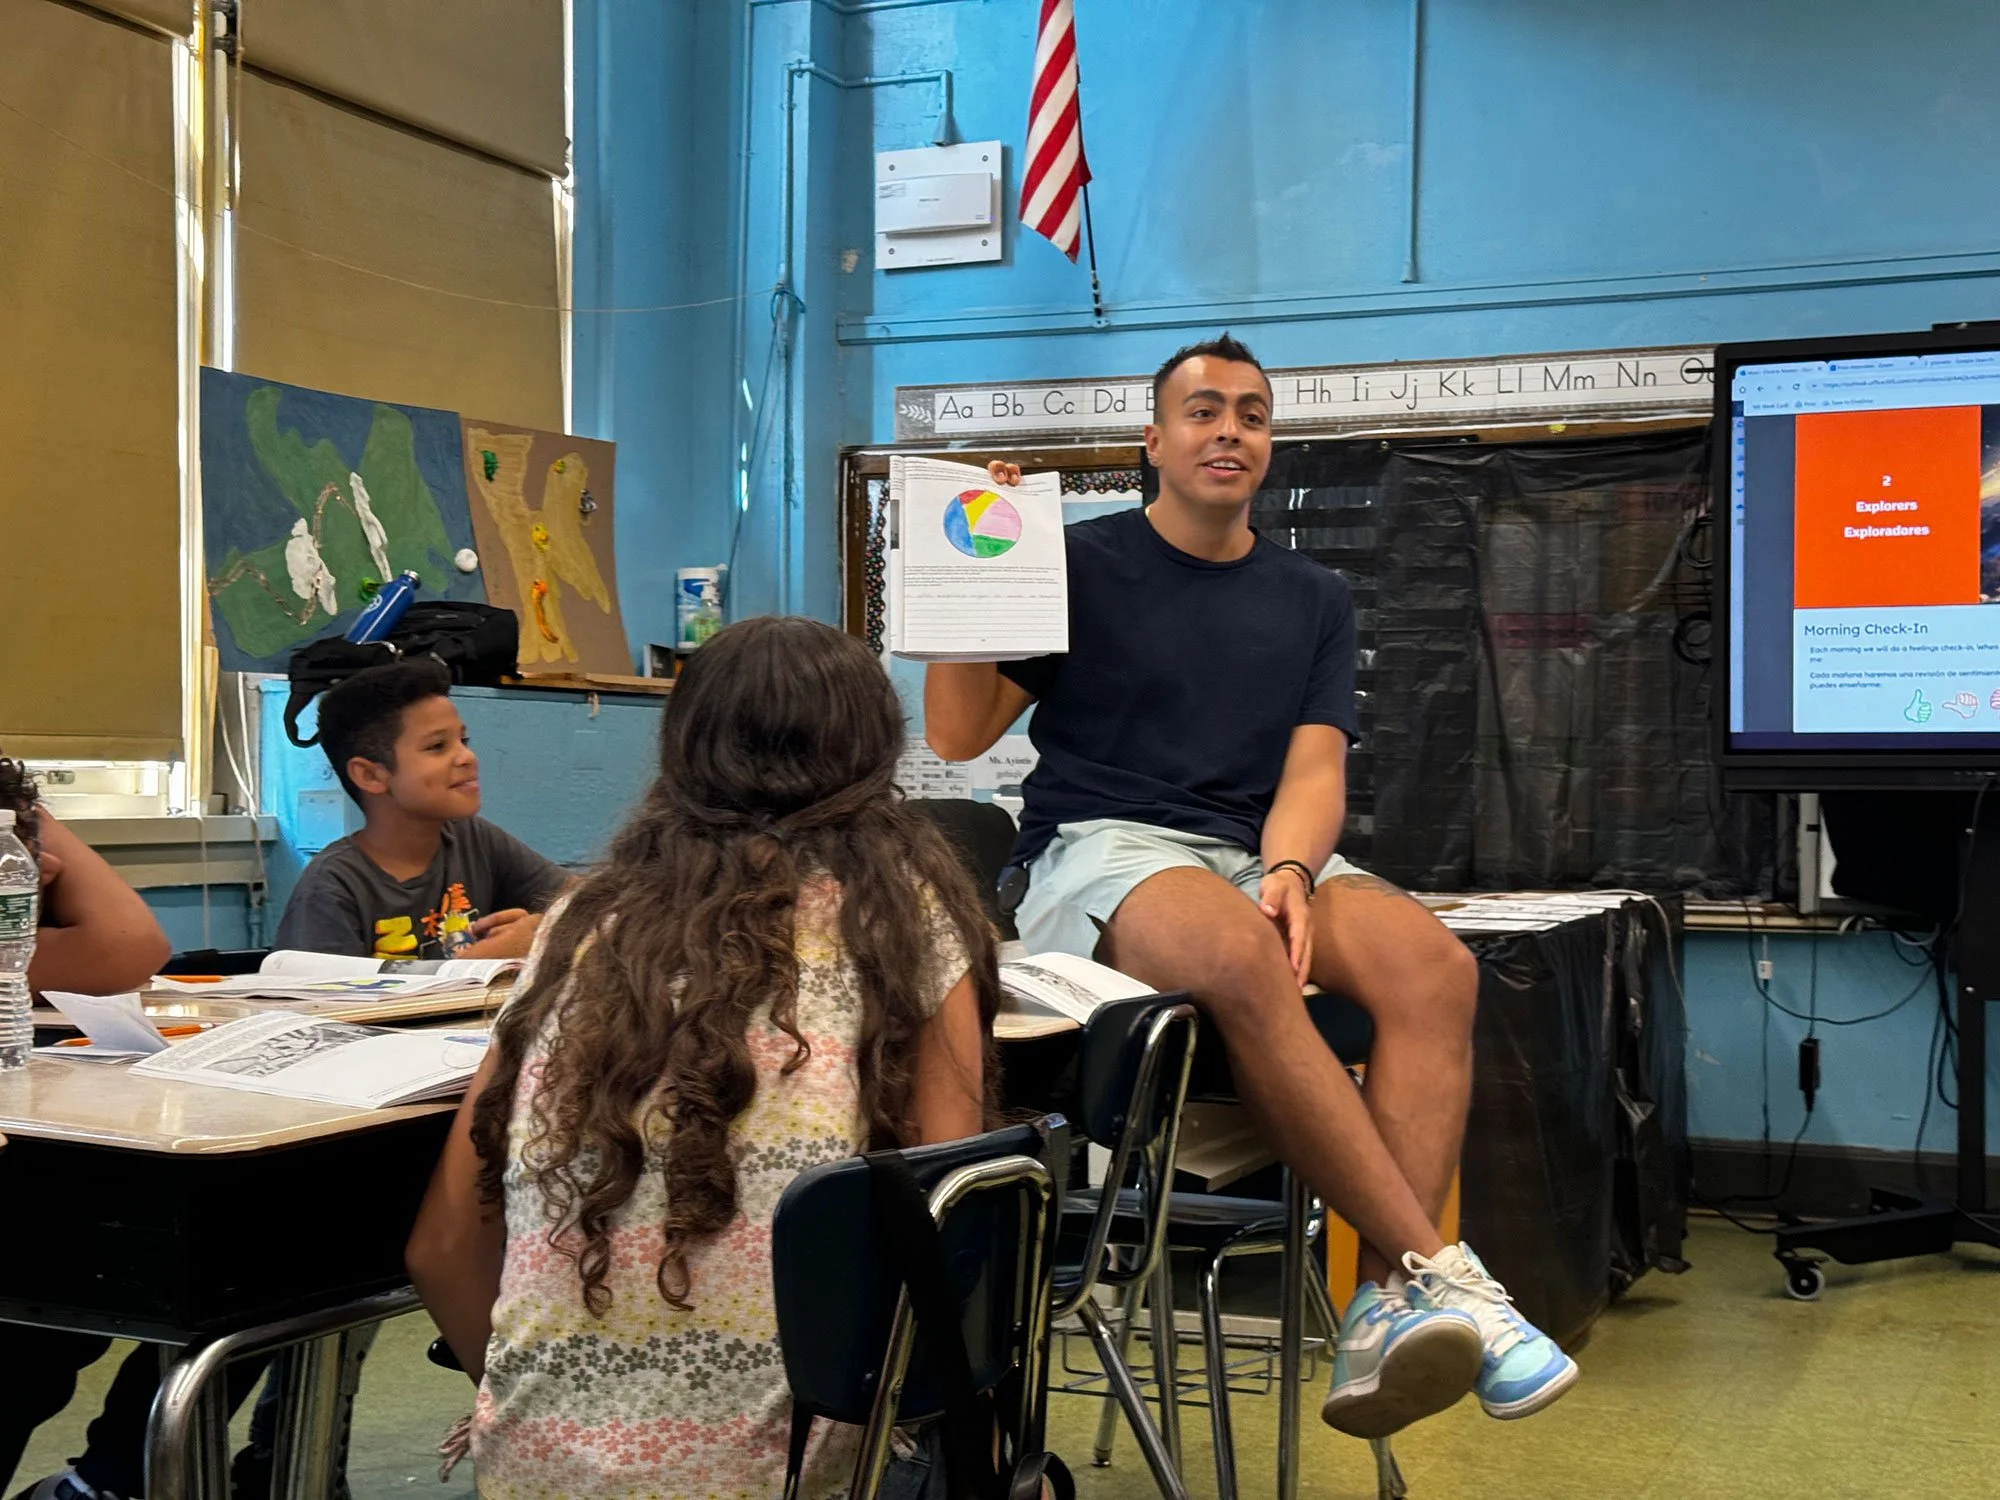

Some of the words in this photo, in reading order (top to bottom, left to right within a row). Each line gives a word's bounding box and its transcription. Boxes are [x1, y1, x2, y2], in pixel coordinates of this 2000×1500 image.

[938, 395, 973, 420] Aa
[991, 393, 1024, 417] Bb
[1043, 390, 1075, 415] Cc
[1094, 387, 1126, 413] Dd
[1296, 378, 1331, 405] Hh
[1352, 376, 1370, 402] Ii
[1390, 373, 1418, 410] Jj
[1439, 371, 1474, 397] Kk
[1544, 364, 1595, 392] Mm
[1617, 360, 1657, 389] Nn
[1882, 475, 1892, 487] 2
[1856, 501, 1918, 514] Explorers
[1844, 525, 1929, 540] Exploradores
[1804, 623, 1860, 638] Morning
[1865, 622, 1929, 635] Check-In
